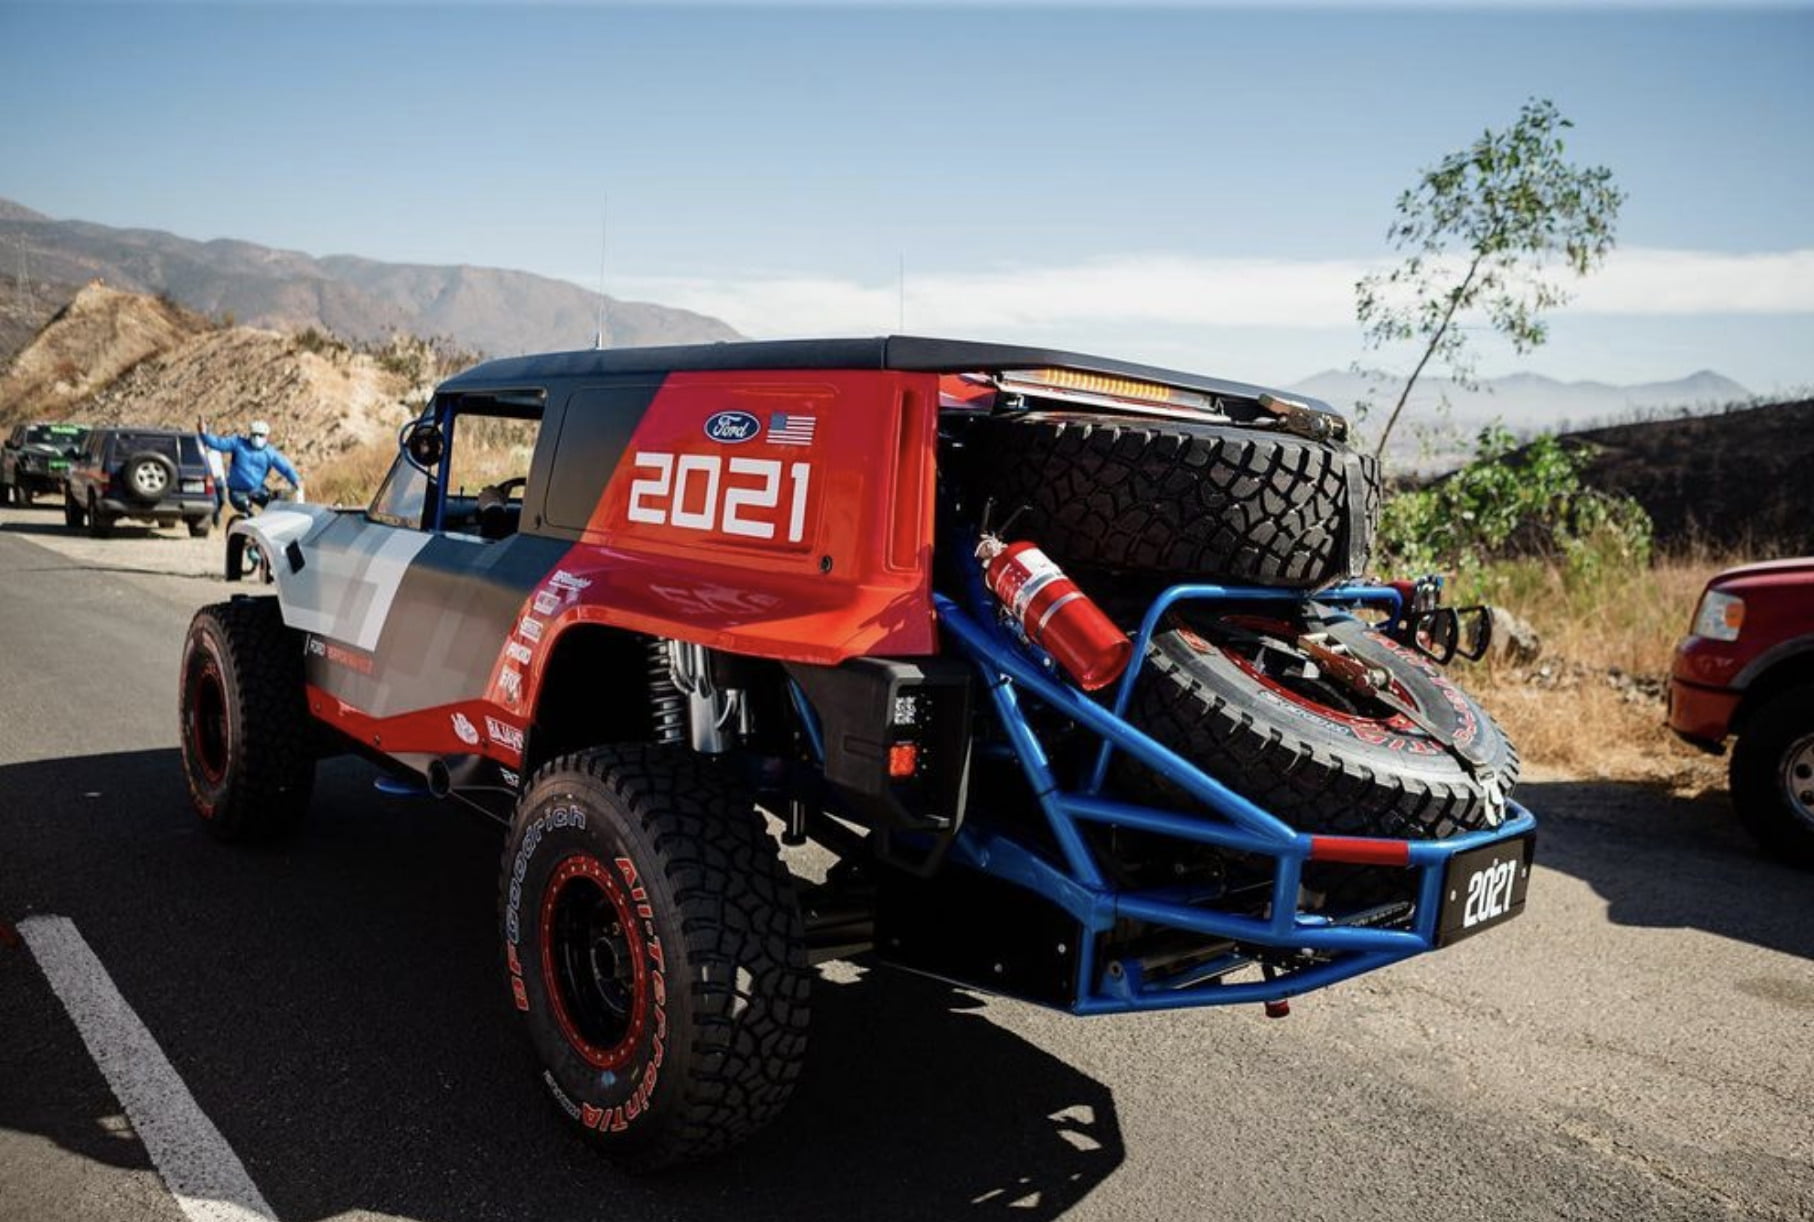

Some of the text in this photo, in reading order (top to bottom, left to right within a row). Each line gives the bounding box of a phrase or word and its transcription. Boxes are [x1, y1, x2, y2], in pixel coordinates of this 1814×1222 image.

[711, 414, 750, 439] Ford
[628, 451, 811, 543] 2021
[1463, 859, 1517, 928] 2021
